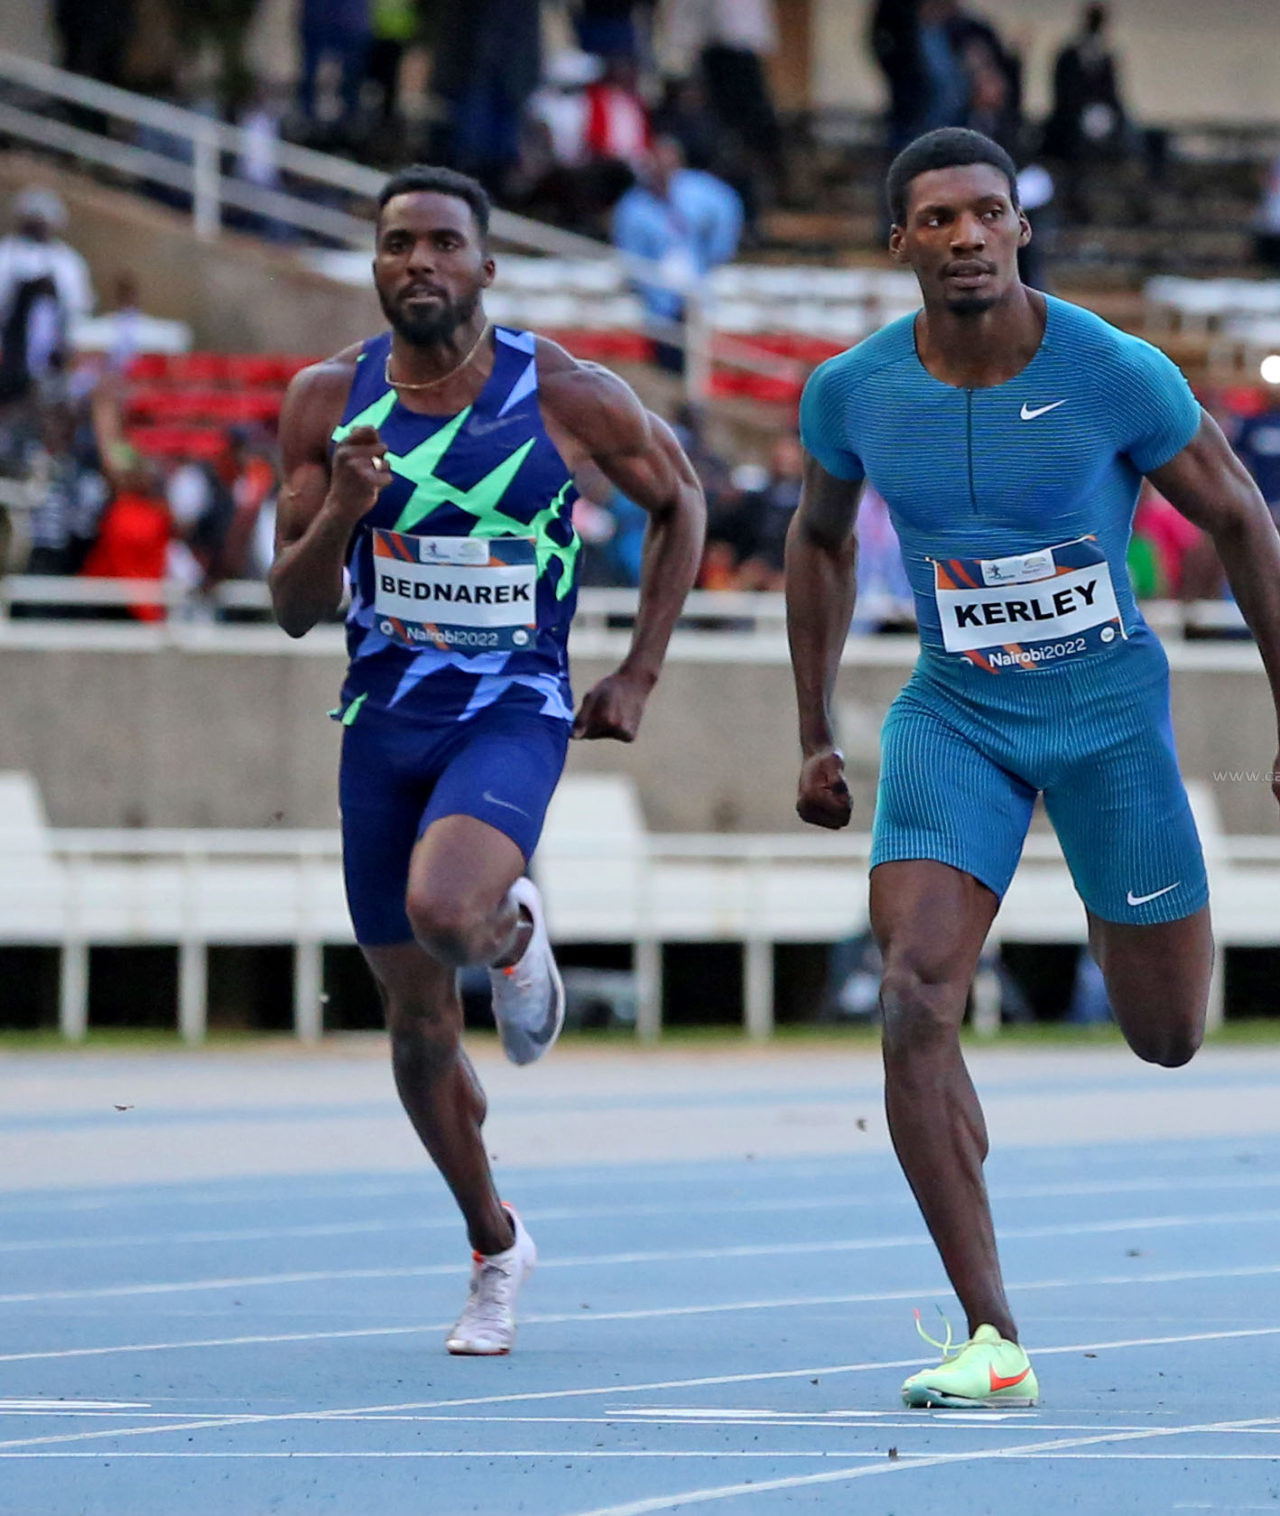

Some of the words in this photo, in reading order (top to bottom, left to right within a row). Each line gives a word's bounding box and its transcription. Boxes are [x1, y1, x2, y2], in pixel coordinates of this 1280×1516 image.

[381, 575, 530, 604] BEDNAREK
[954, 580, 1097, 628] KERLEY
[406, 627, 498, 646] Nairobi2022
[989, 638, 1087, 667] Nairobi2022
